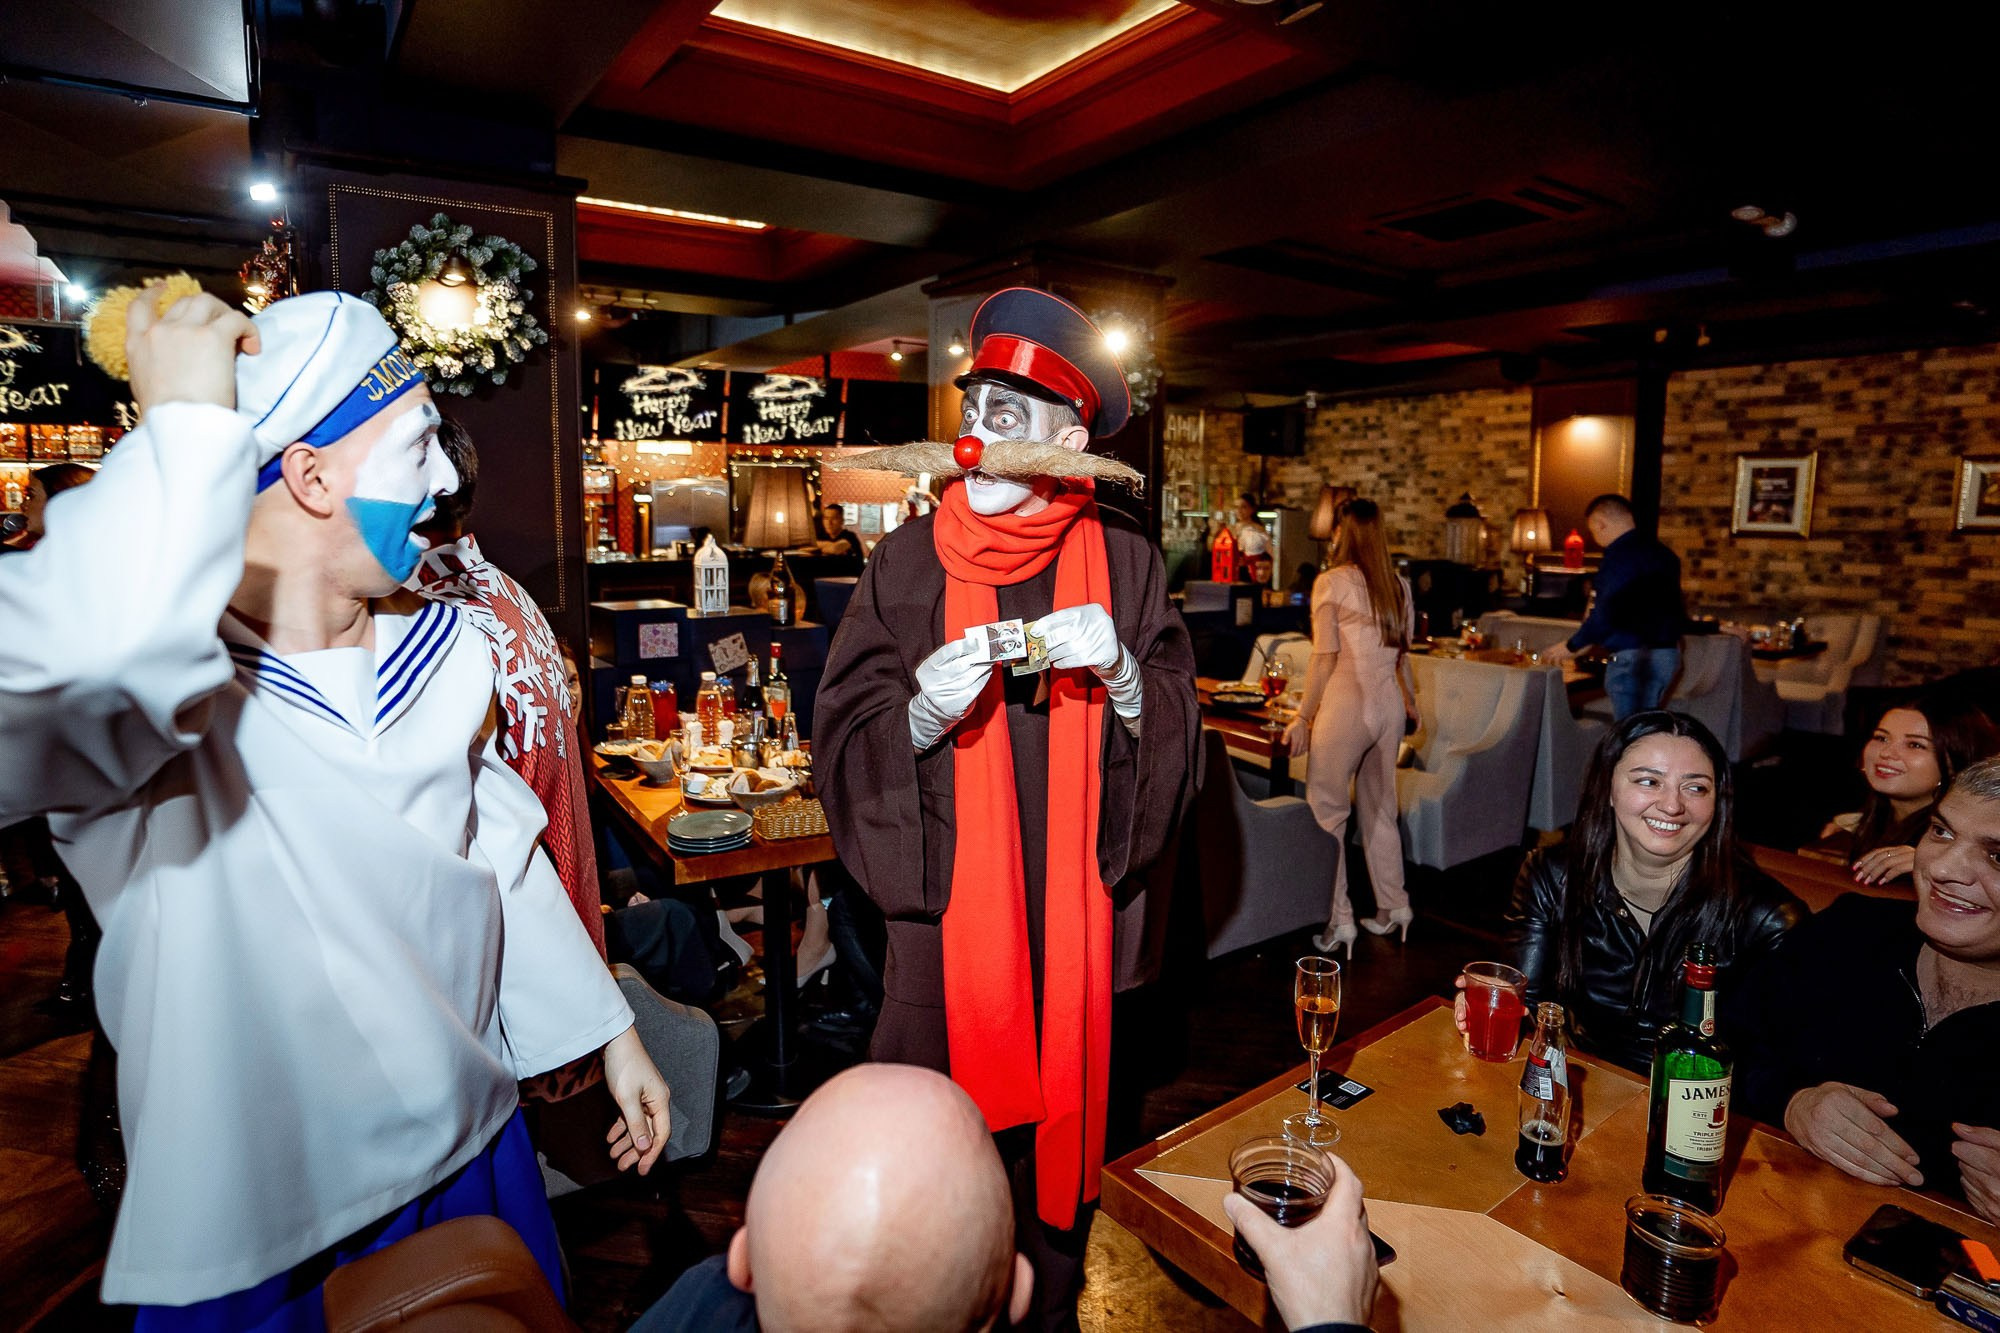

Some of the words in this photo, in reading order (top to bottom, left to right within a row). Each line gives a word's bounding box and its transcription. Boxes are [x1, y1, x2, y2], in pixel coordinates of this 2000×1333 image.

[632, 394, 690, 418] Happy
[759, 400, 812, 424] Happy
[614, 419, 665, 441] New
[667, 411, 718, 435] Year
[743, 422, 788, 445] New
[789, 416, 835, 439] Year
